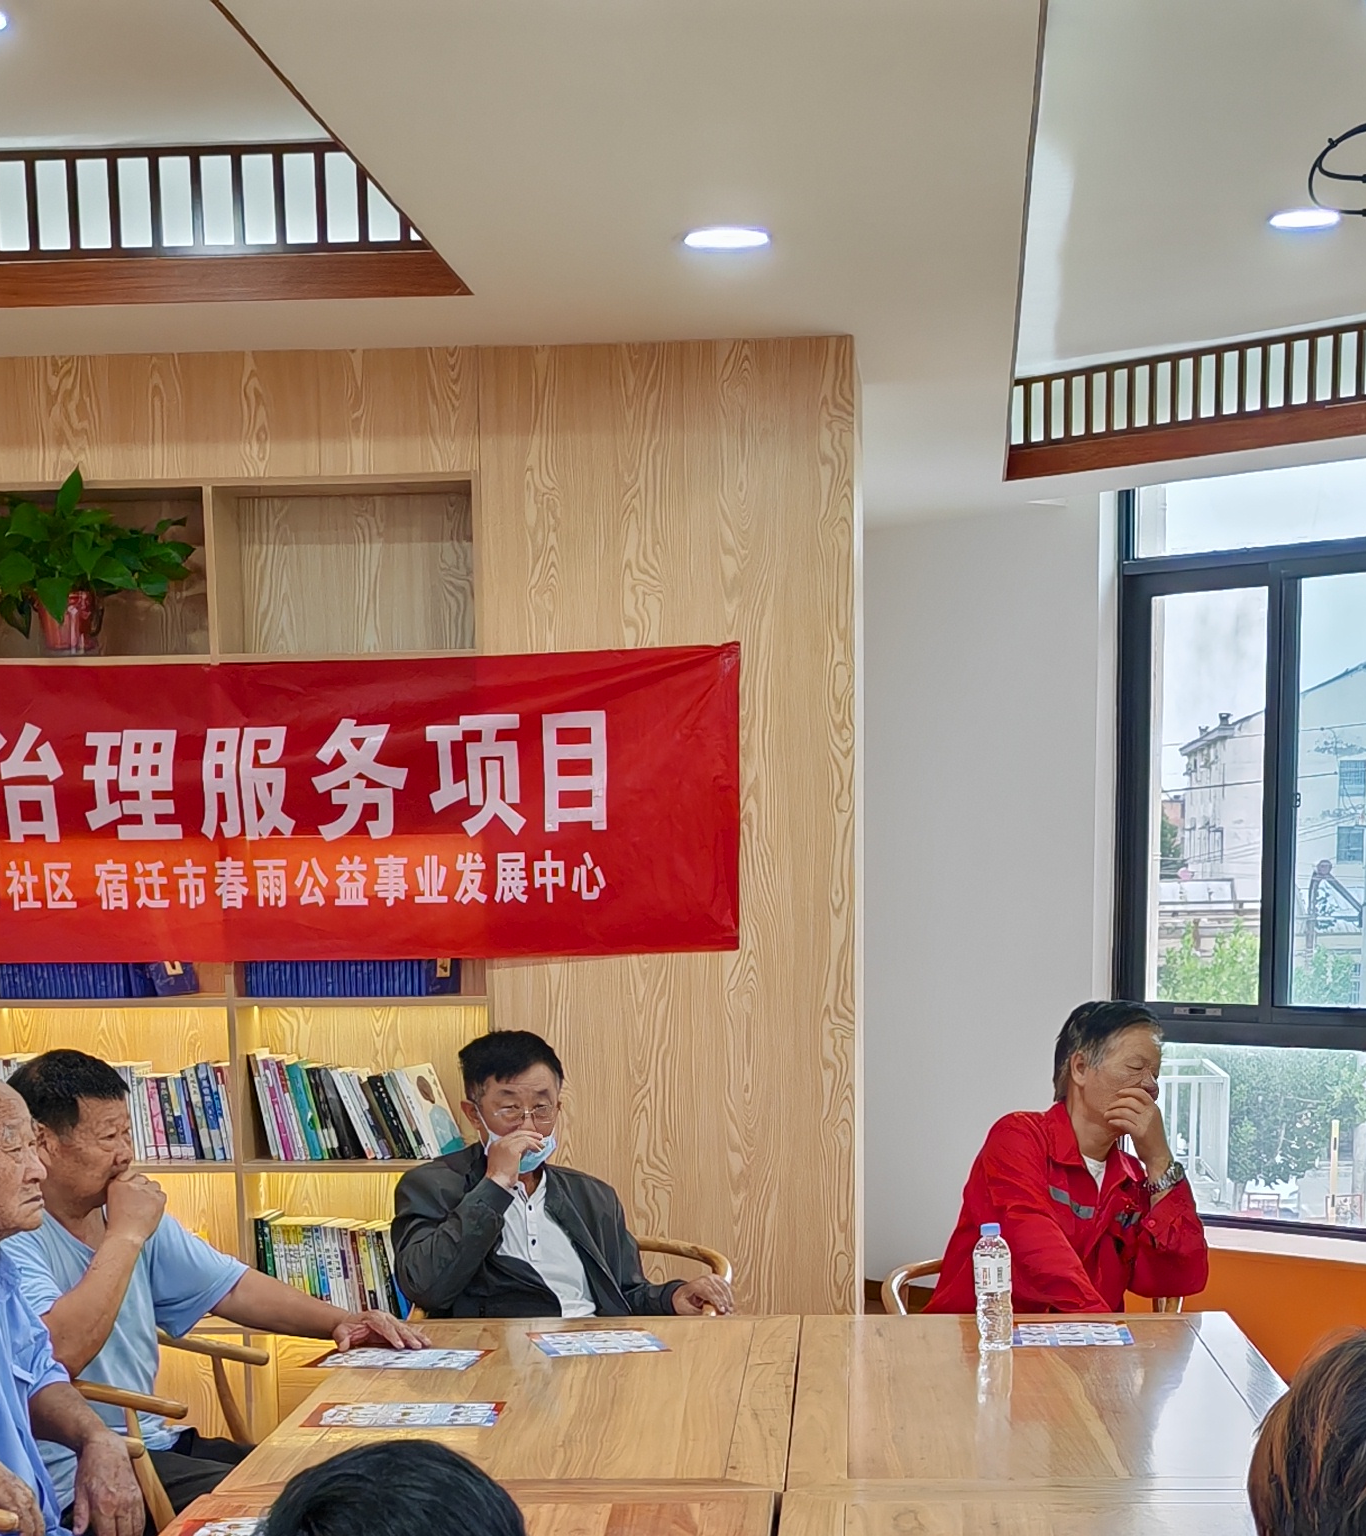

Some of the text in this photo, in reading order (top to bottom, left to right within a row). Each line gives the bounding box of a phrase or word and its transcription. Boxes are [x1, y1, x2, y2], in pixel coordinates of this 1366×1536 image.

[95, 849, 607, 910] 宿迁市春雨公益事业发展中心
